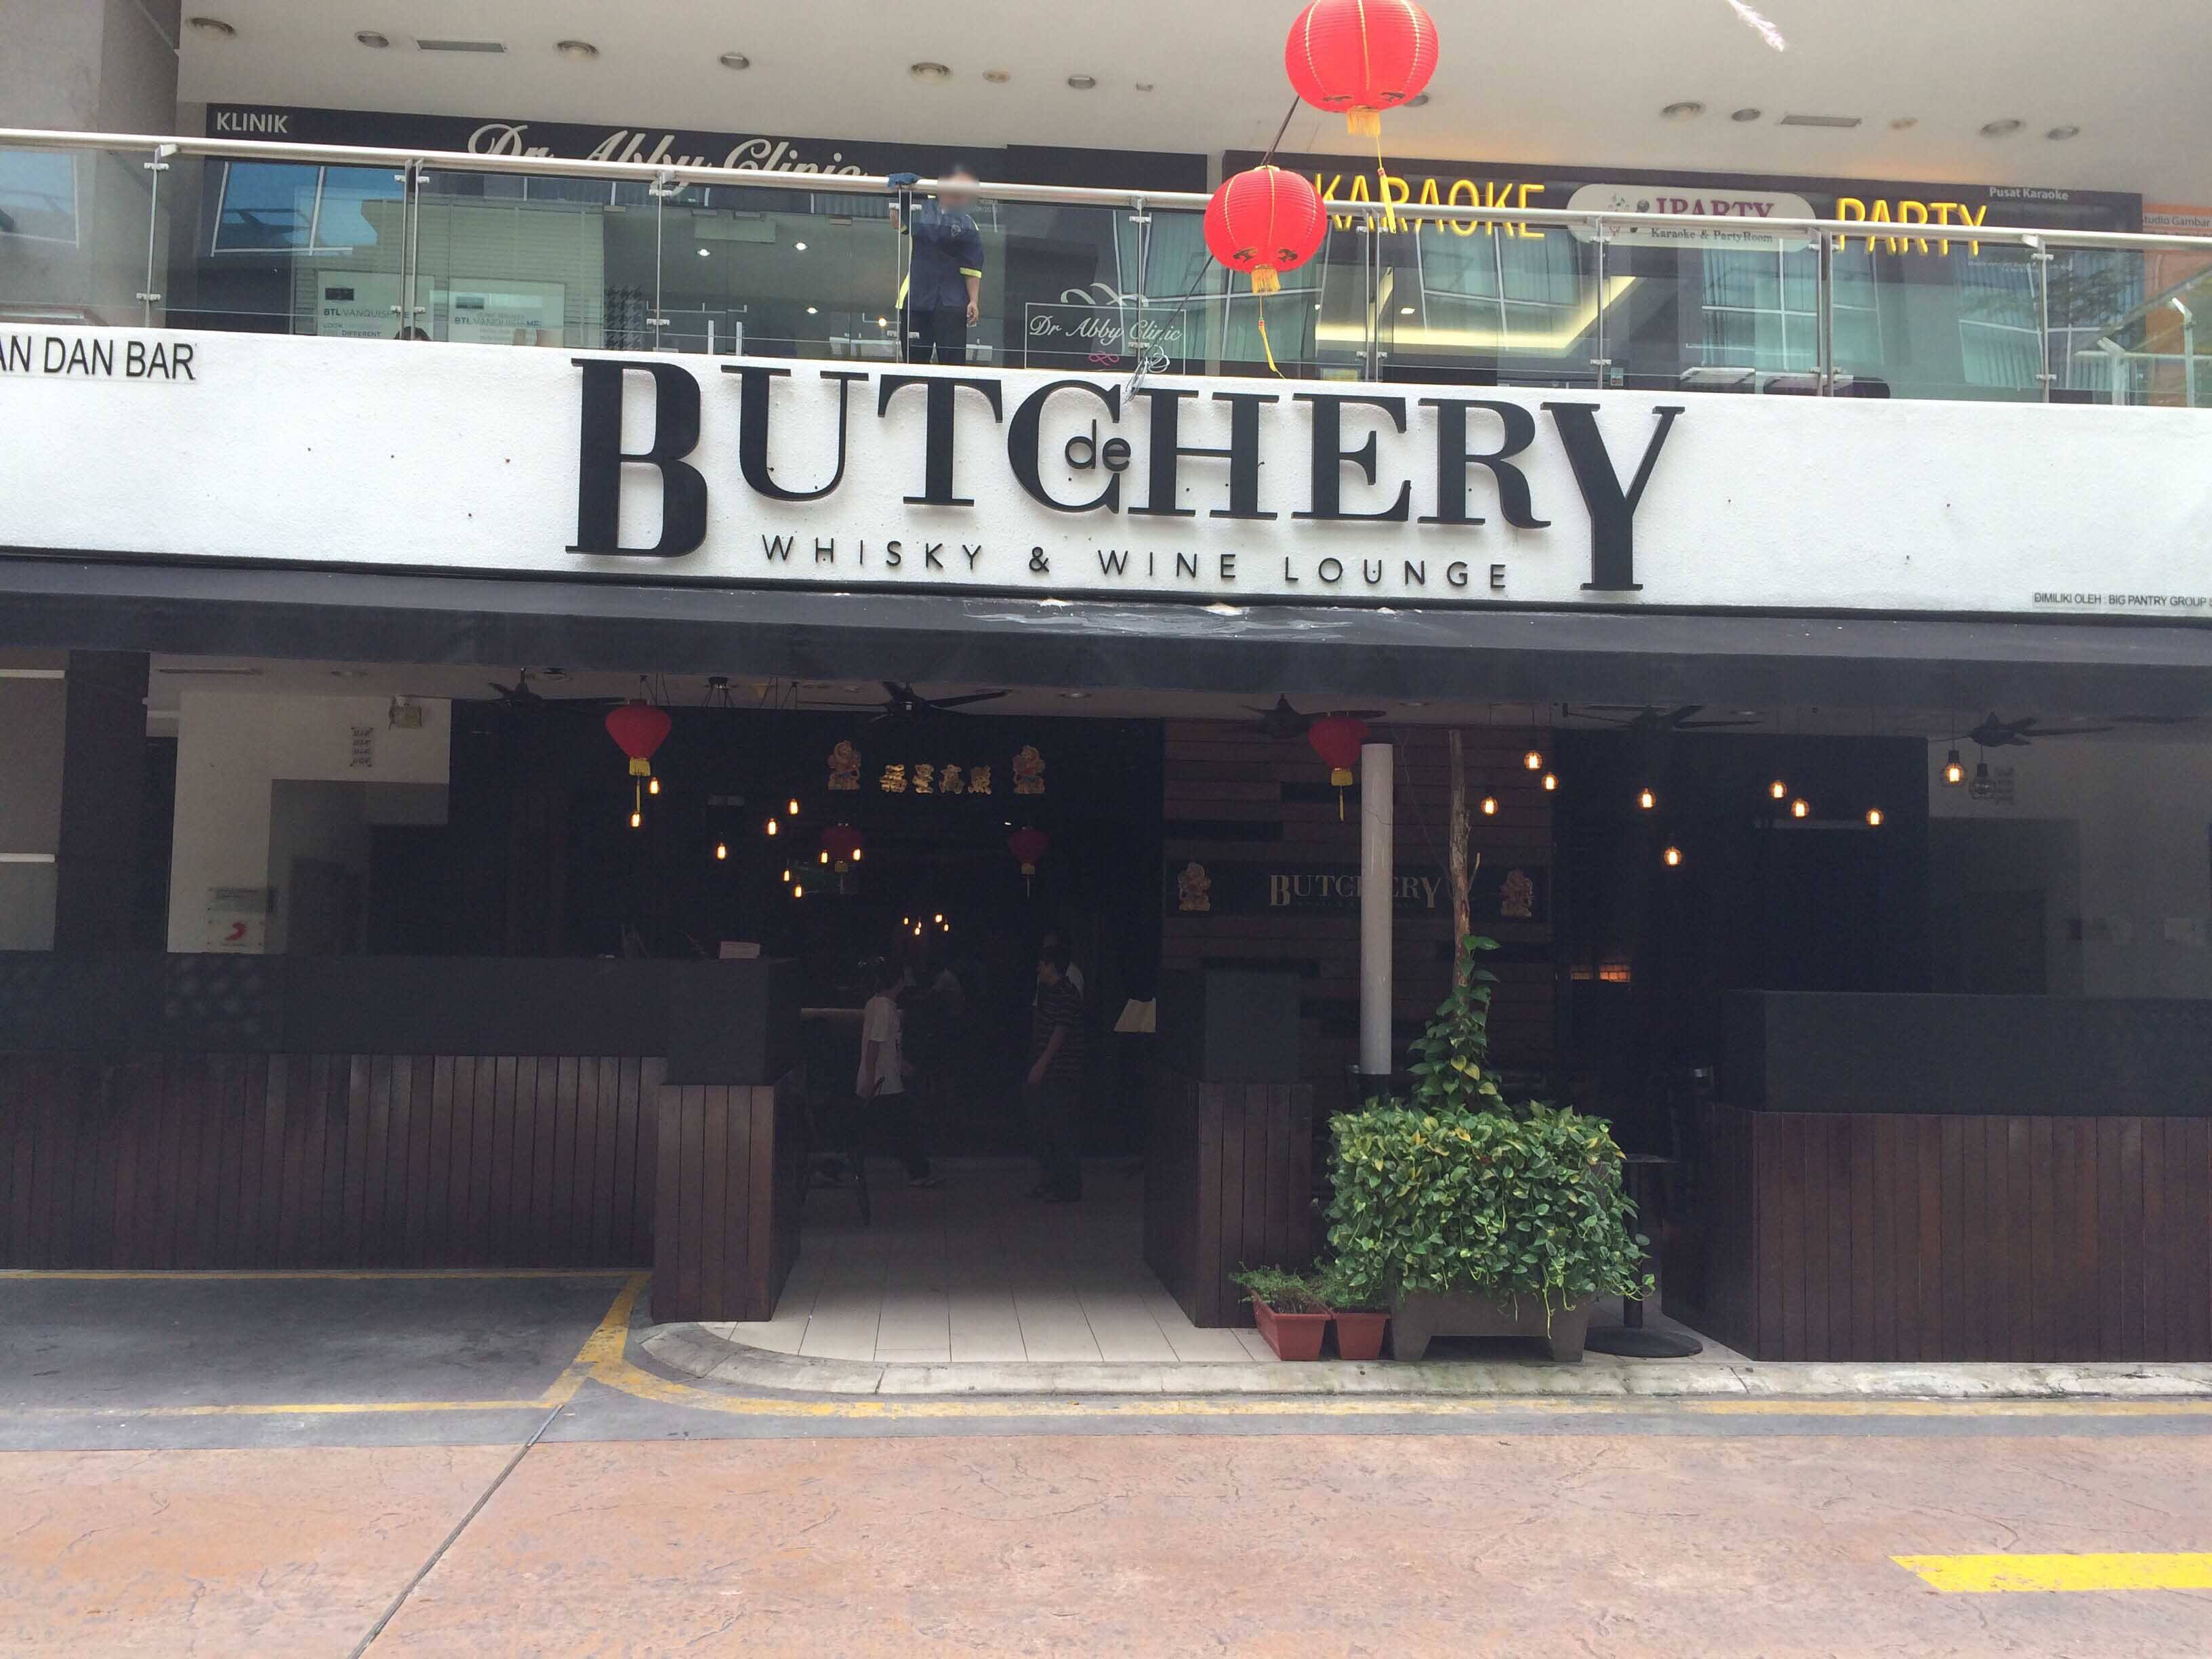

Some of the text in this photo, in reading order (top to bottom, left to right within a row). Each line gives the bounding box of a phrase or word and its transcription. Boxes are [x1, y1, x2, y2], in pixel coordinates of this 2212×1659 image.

[217, 112, 287, 134] KLINIK
[1315, 173, 1545, 239] KARAOKE
[1989, 186, 2068, 201] Pusat Karaoke
[1651, 226, 1696, 239] Karaoke
[1700, 229, 1711, 239] &
[1837, 197, 1988, 255] PARTY
[2142, 216, 2209, 228] tudio Gambar
[1029, 315, 1183, 346] Dr Abby Clinic
[44, 337, 114, 375] DAN
[126, 341, 195, 380] BAR
[1065, 419, 1132, 472] de
[565, 357, 1685, 592] BUTCHERY
[761, 534, 1507, 589] WHISKY & WINE LOUNGE
[2074, 593, 2102, 605] OLEH
[2108, 594, 2126, 605] BIG
[2128, 594, 2167, 607] PANTRY
[2169, 596, 2207, 607] GROUP
[1269, 874, 1441, 908] BUTCRY
